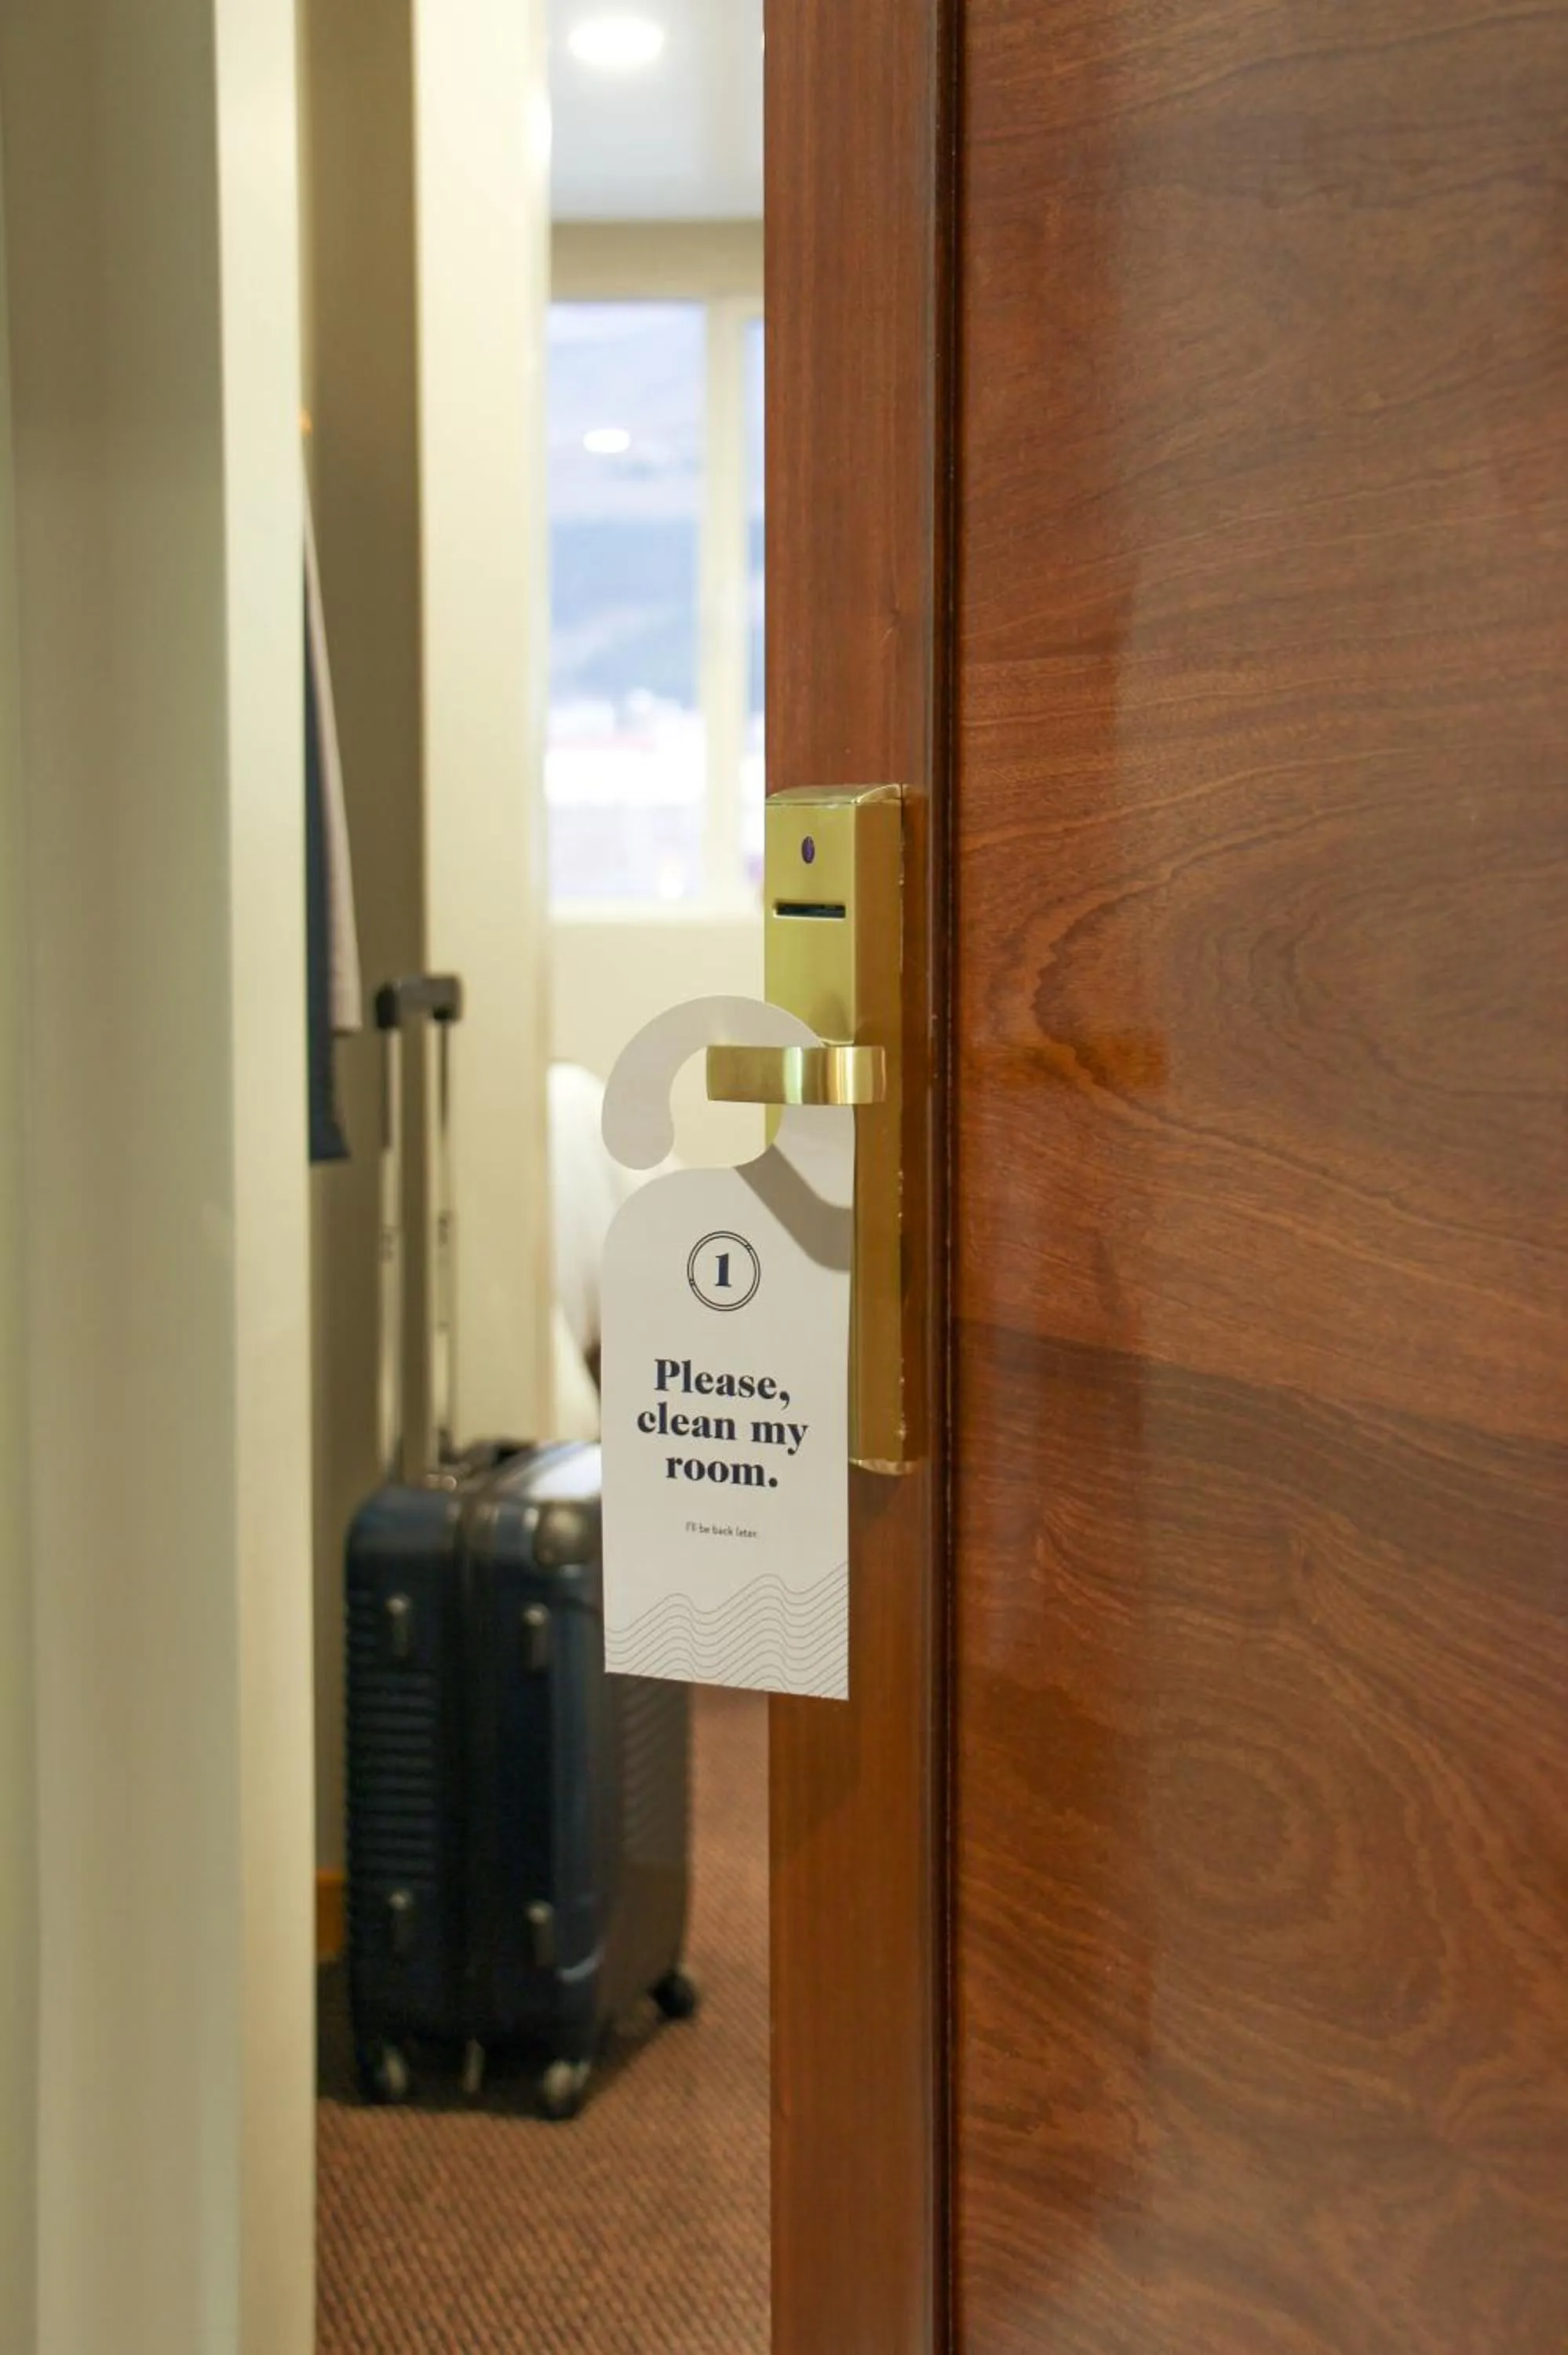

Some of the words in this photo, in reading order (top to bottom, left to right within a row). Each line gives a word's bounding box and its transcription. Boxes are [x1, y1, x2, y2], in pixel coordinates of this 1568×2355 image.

[715, 1253, 731, 1287] 1
[654, 1358, 790, 1409] Please,
[636, 1402, 737, 1440] clean
[750, 1421, 809, 1456] my
[665, 1457, 778, 1488] room.
[698, 1522, 710, 1534] be
[712, 1524, 733, 1536] back
